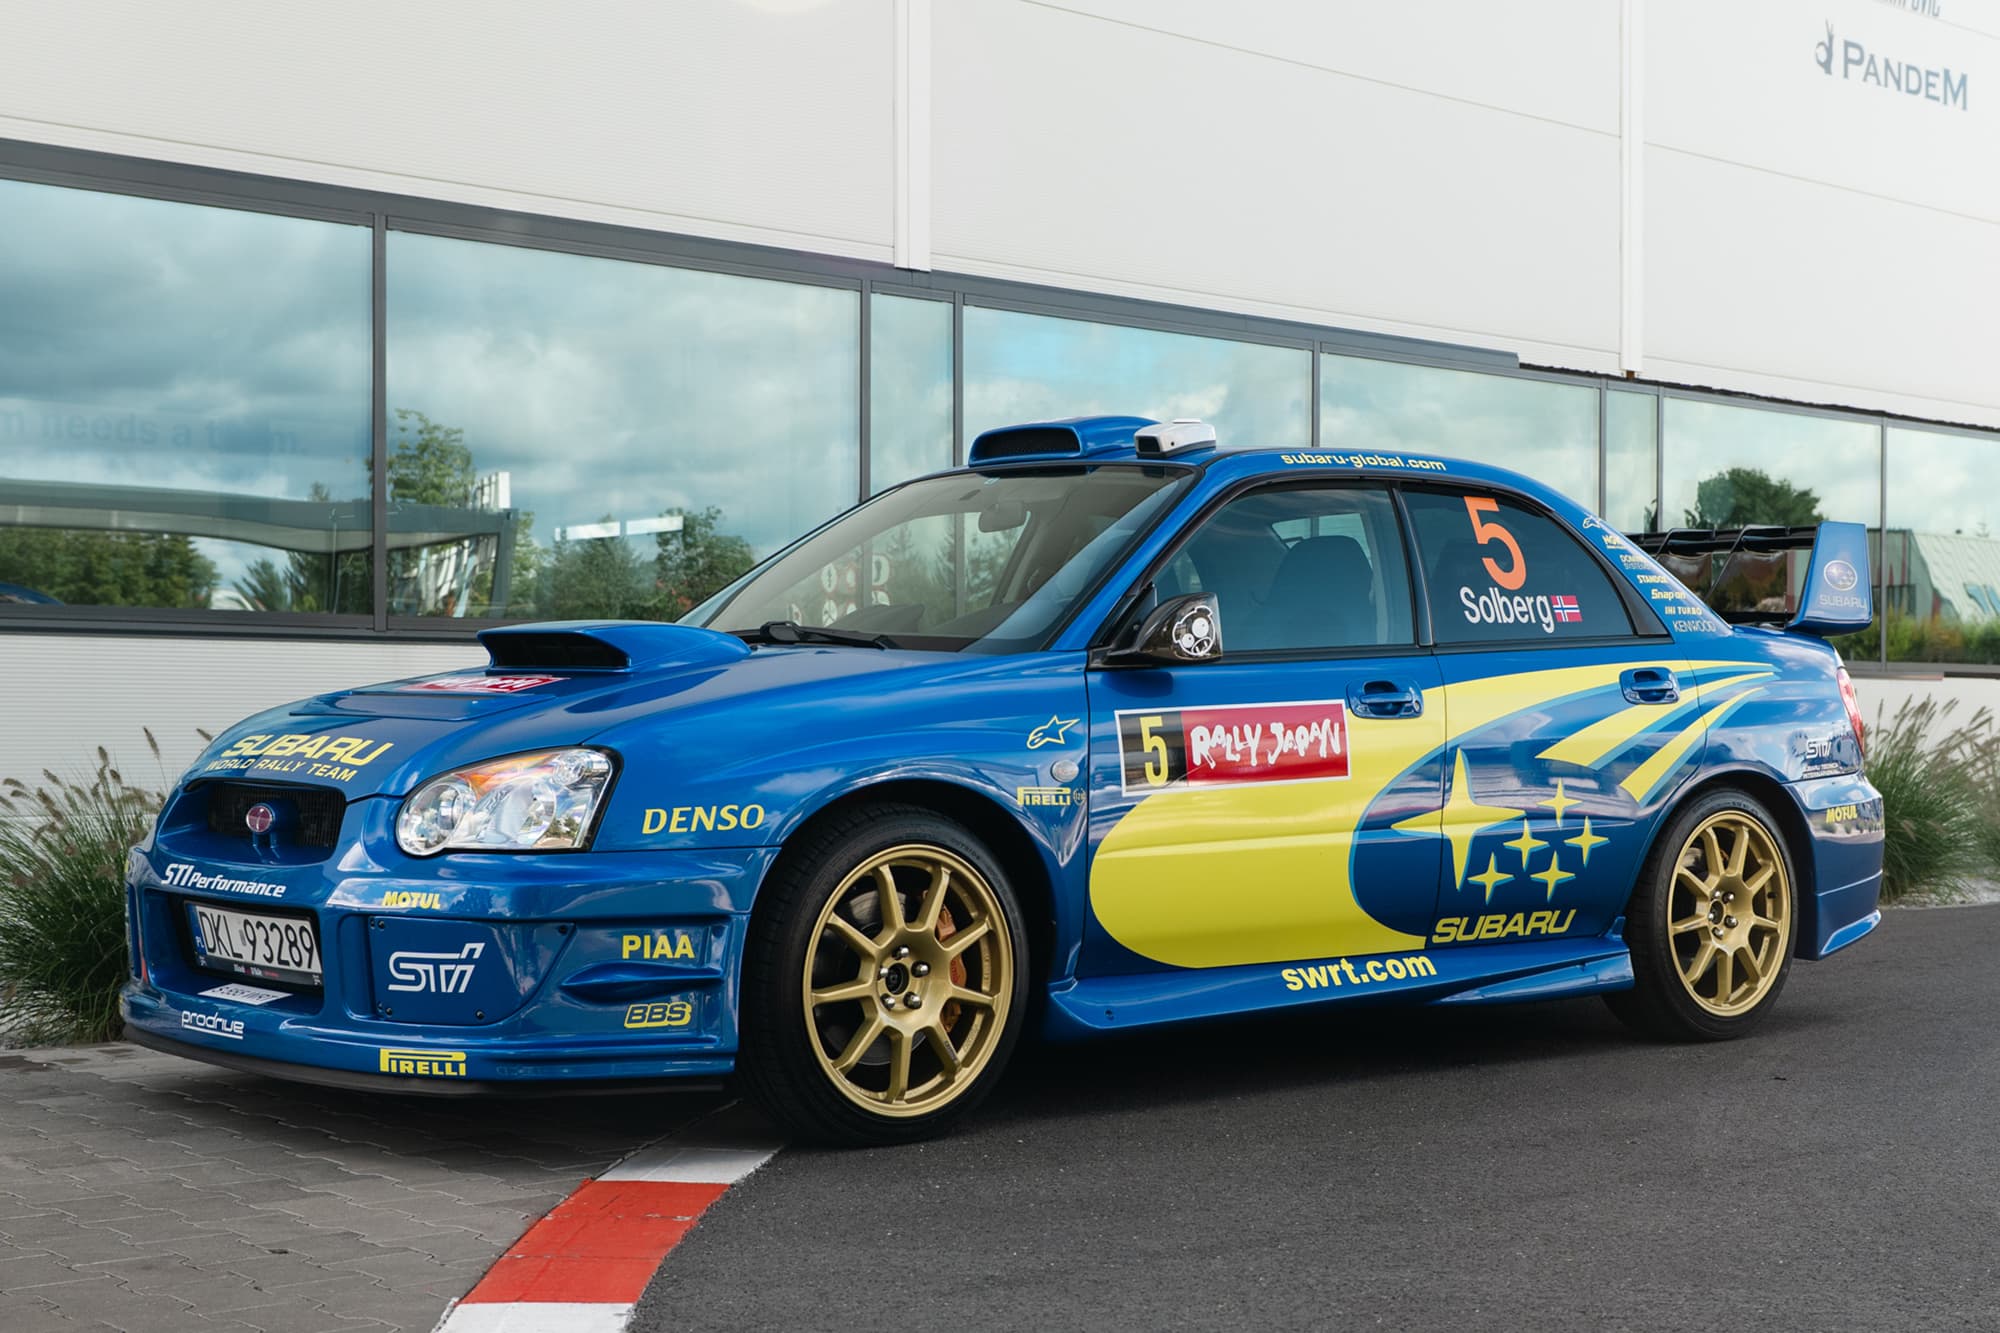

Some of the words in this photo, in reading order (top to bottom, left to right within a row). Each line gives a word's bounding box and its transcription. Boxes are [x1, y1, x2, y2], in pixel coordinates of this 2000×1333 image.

[1281, 452, 1447, 471] subaru-global.com
[1463, 495, 1527, 591] 5
[1459, 586, 1556, 634] Solberg
[1677, 606, 1703, 616] TURBO
[1818, 594, 1868, 610] SUBARU
[1672, 619, 1717, 633] KENWOOD
[220, 733, 395, 767] SUBARU
[1139, 715, 1169, 787] 5
[1189, 723, 1262, 769] RALLY
[1267, 718, 1342, 765] JAPAN
[205, 757, 252, 773] WORLD
[255, 758, 304, 773] RALLY
[308, 762, 357, 782] TEAM
[1016, 786, 1071, 806] PIRELLI
[641, 804, 765, 835] DENSO
[1826, 805, 1859, 823] MOTUL
[188, 872, 287, 898] Performance
[381, 890, 441, 910] MOTUL
[1431, 908, 1577, 944] SUBARU
[198, 910, 244, 960] DKL
[243, 918, 315, 970] 93289
[621, 934, 696, 960] PIAA
[1280, 955, 1438, 991] swrt.com
[181, 1010, 245, 1034] prodrive
[626, 1003, 688, 1027] BBS
[379, 1049, 467, 1076] PIRELLI
